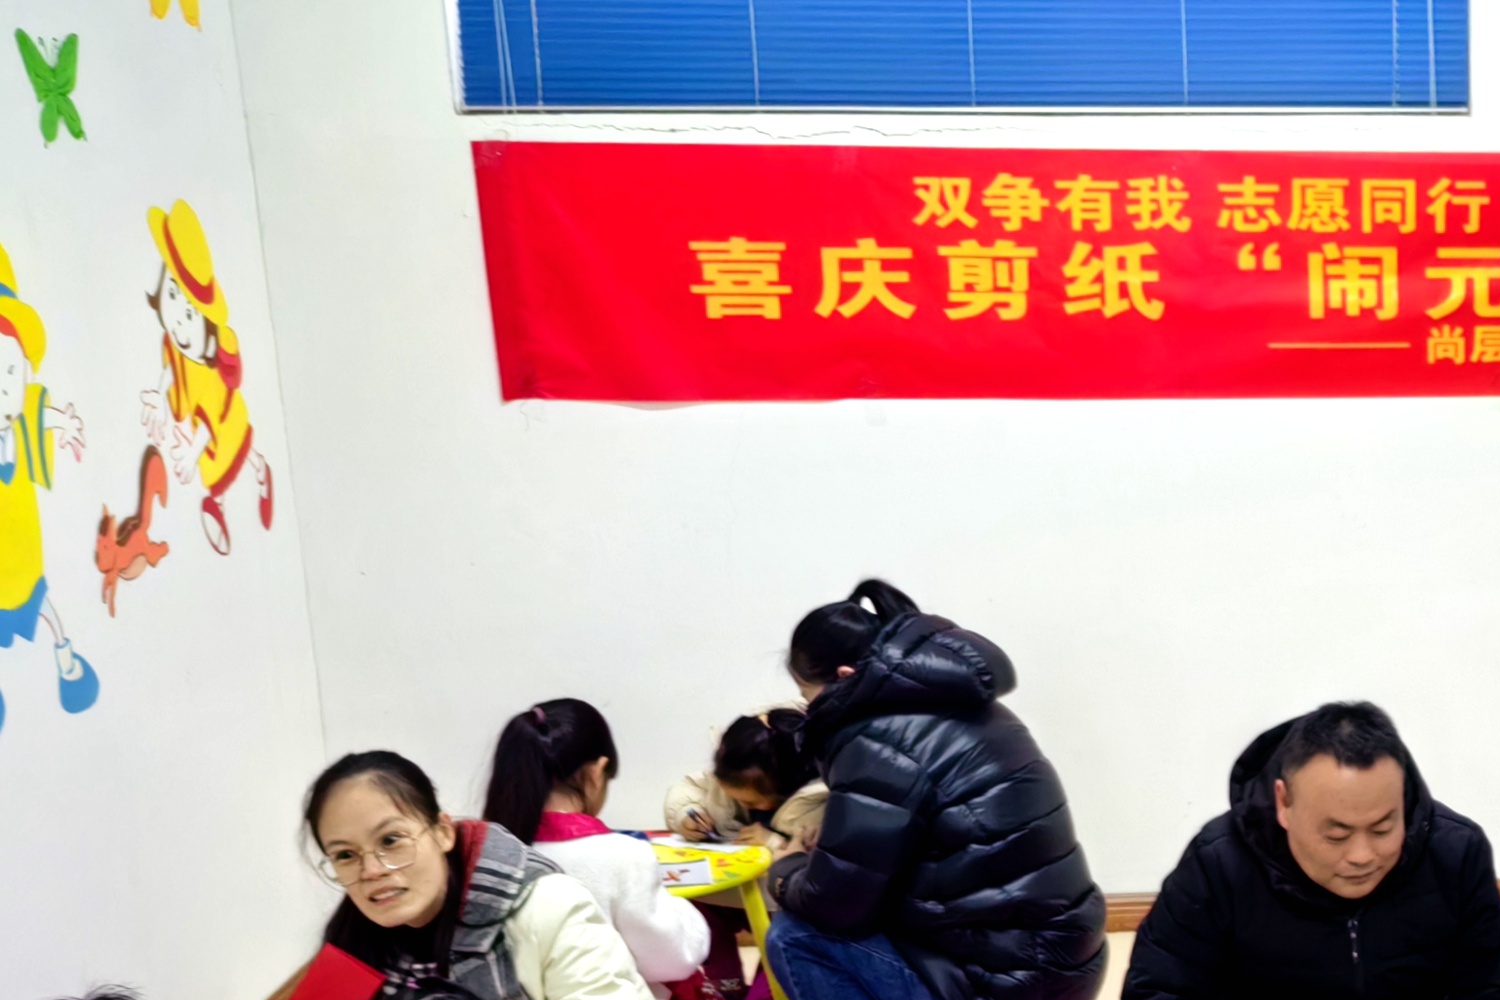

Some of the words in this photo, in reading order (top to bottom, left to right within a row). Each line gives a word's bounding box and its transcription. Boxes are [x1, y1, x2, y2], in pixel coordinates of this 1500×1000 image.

[912, 173, 1191, 232] 双争有我
[1217, 176, 1491, 233] 志愿同行
